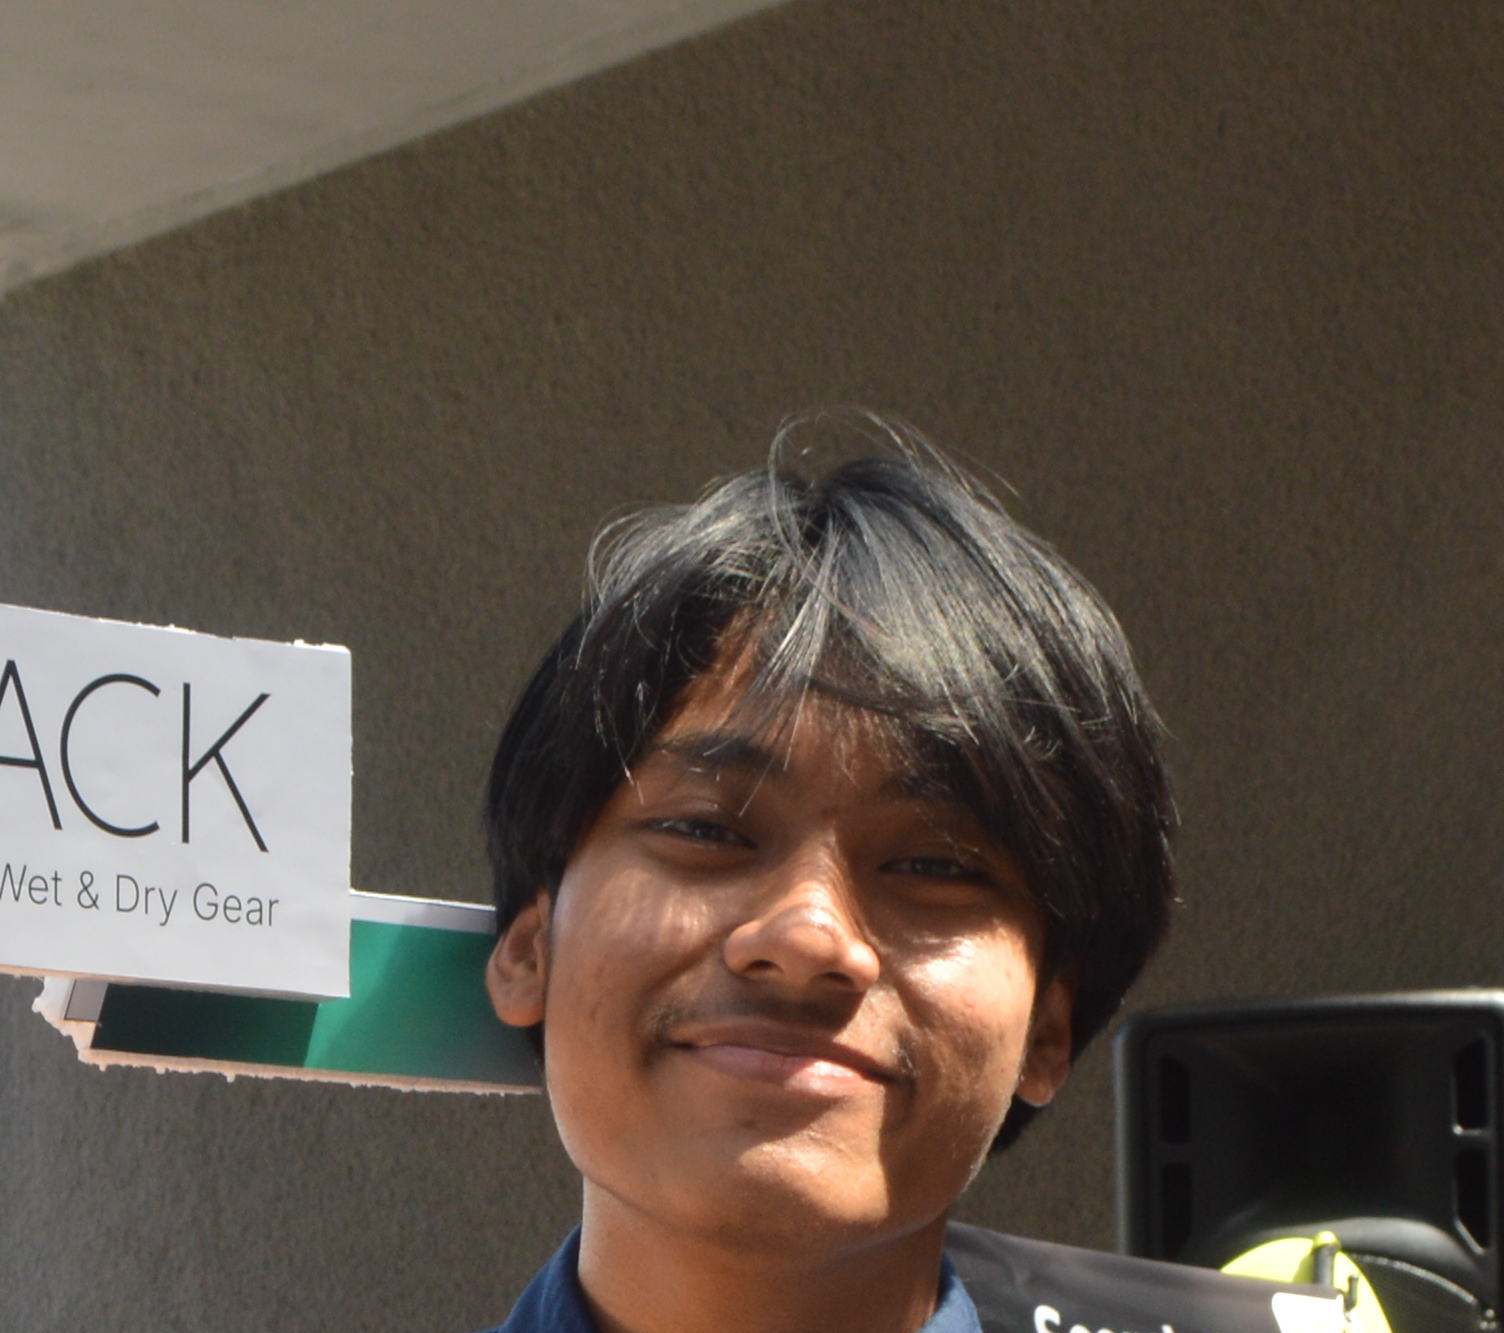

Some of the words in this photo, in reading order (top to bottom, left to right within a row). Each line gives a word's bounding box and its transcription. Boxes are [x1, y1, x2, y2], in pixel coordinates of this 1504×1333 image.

[76, 869, 101, 912] &
[114, 874, 179, 928] Dry
[192, 880, 280, 928] Gear
